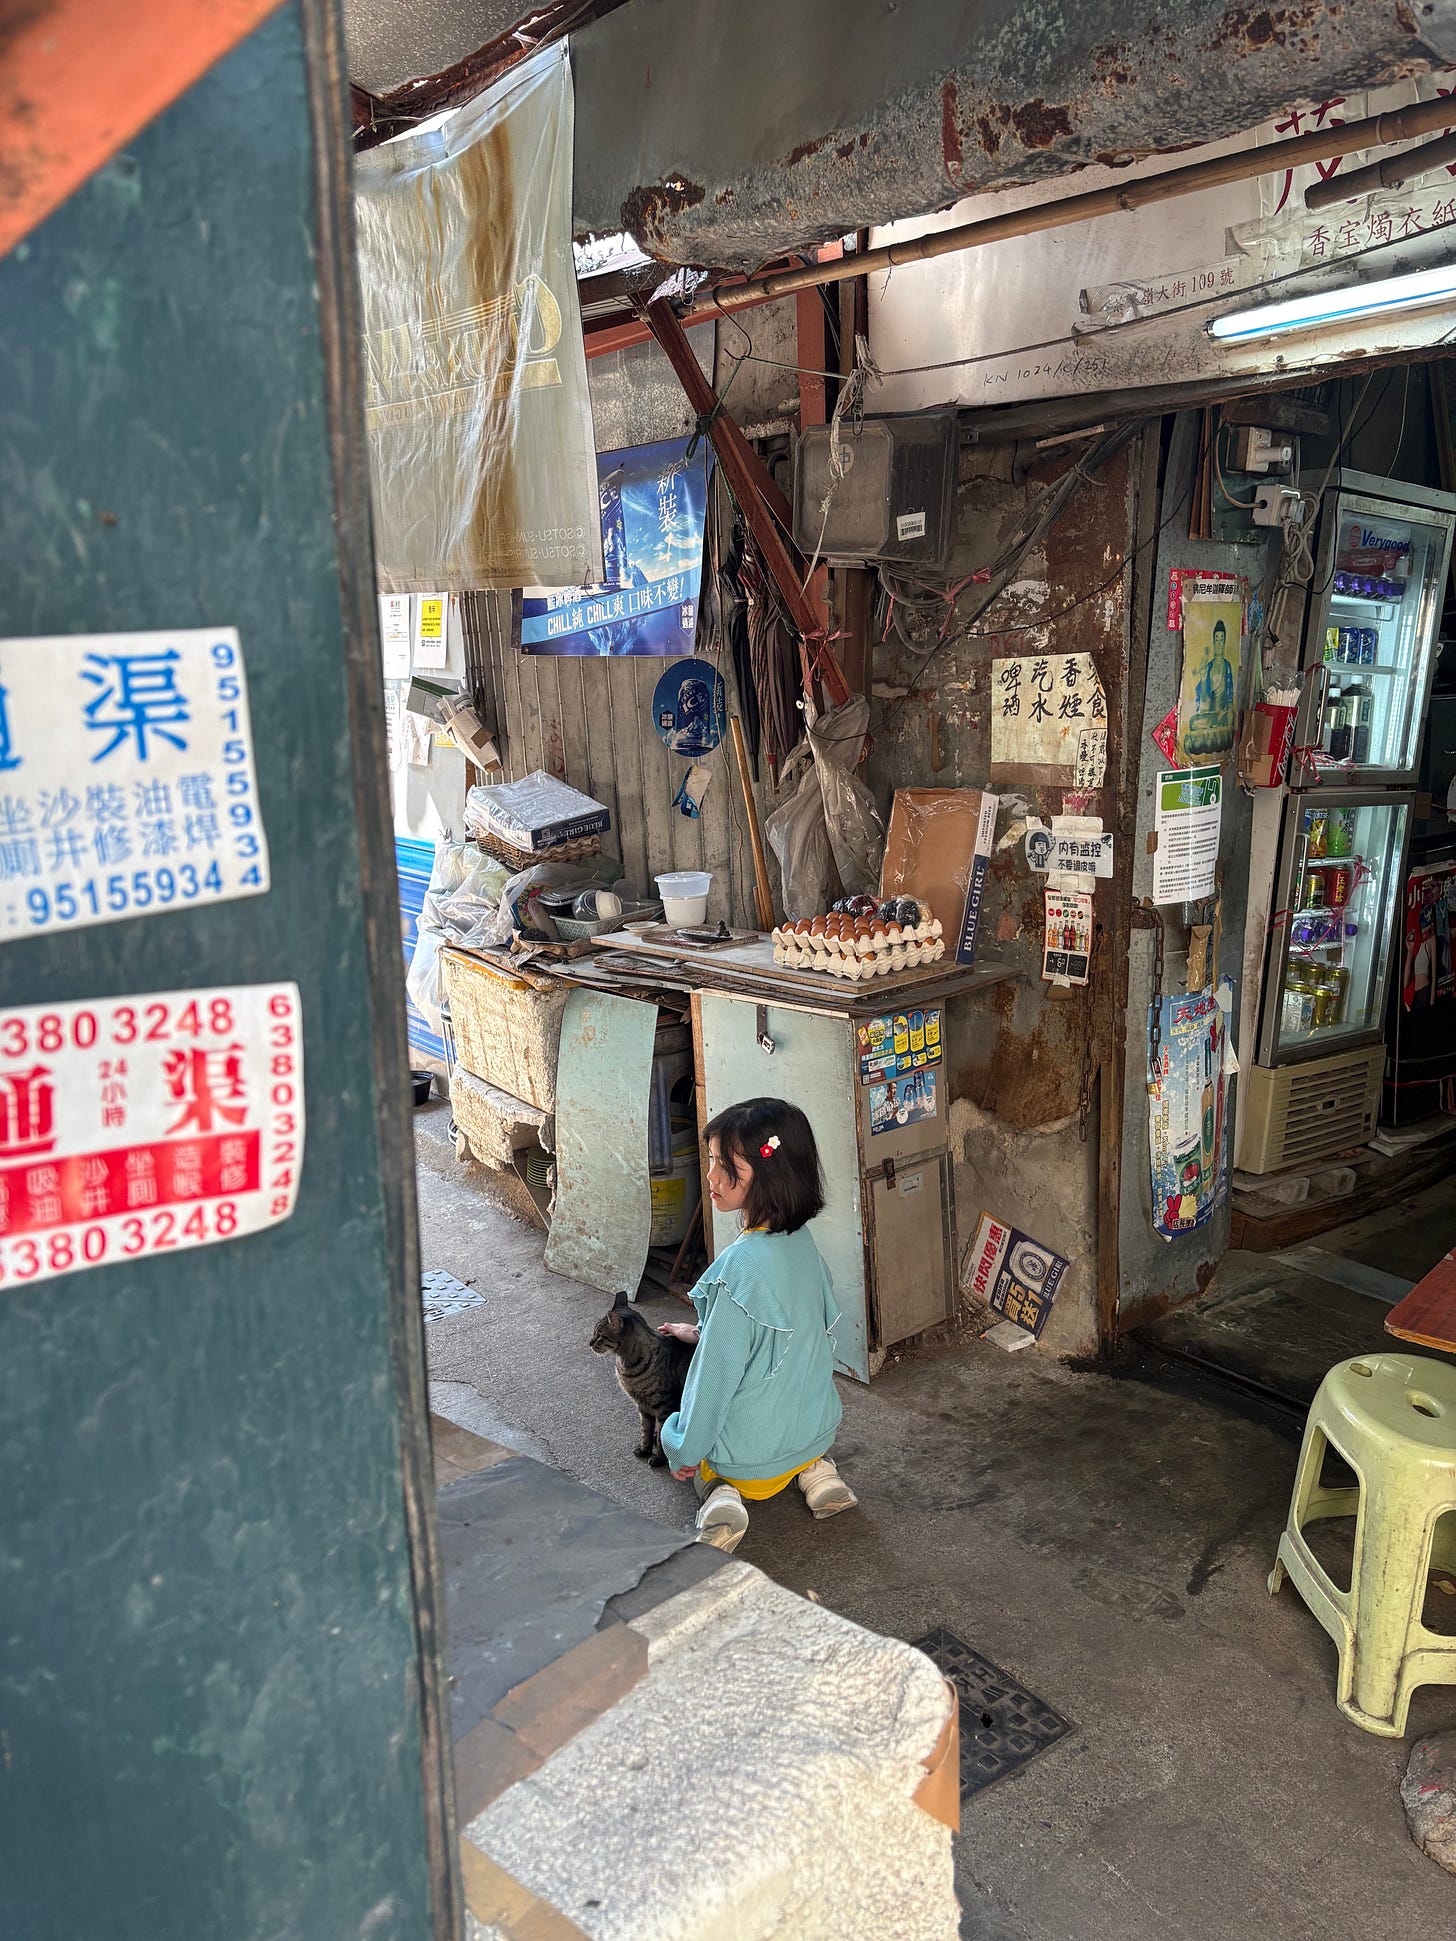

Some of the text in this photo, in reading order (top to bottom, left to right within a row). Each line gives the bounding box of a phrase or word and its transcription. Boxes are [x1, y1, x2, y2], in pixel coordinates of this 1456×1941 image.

[1191, 271, 1215, 293] 109
[983, 371, 1009, 387] KN
[1362, 529, 1411, 552] Verygood
[79, 647, 191, 763] 渠
[211, 643, 262, 888] 95155934
[26, 858, 225, 925] 95155934
[963, 864, 985, 951] BLUE GIRL
[112, 998, 235, 1045] 3248
[161, 1044, 250, 1137] 渠
[267, 994, 296, 1218] 63803248
[0, 1202, 239, 1283] 380 3248
